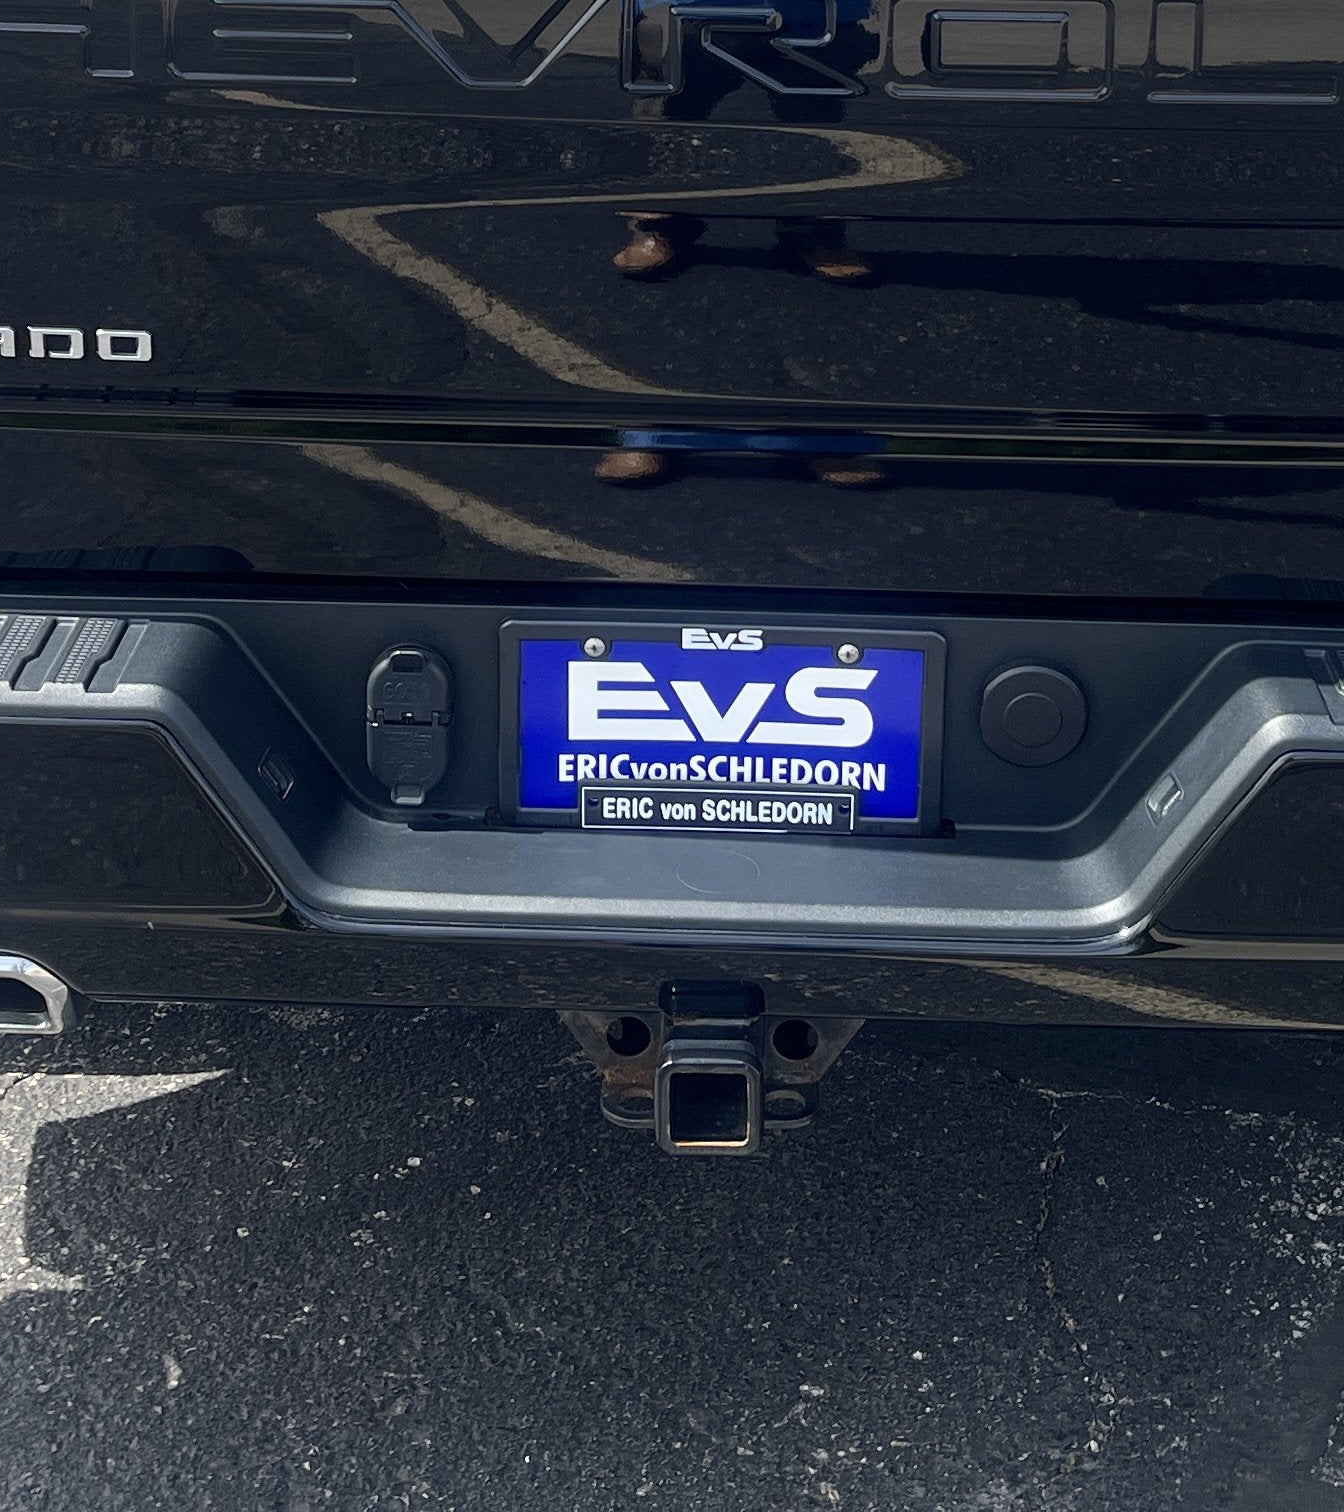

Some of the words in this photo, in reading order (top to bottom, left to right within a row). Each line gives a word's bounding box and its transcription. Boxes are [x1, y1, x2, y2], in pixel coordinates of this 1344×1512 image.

[601, 796, 654, 821] ERIC
[660, 801, 696, 821] von
[701, 798, 833, 826] SCHLEDORN
